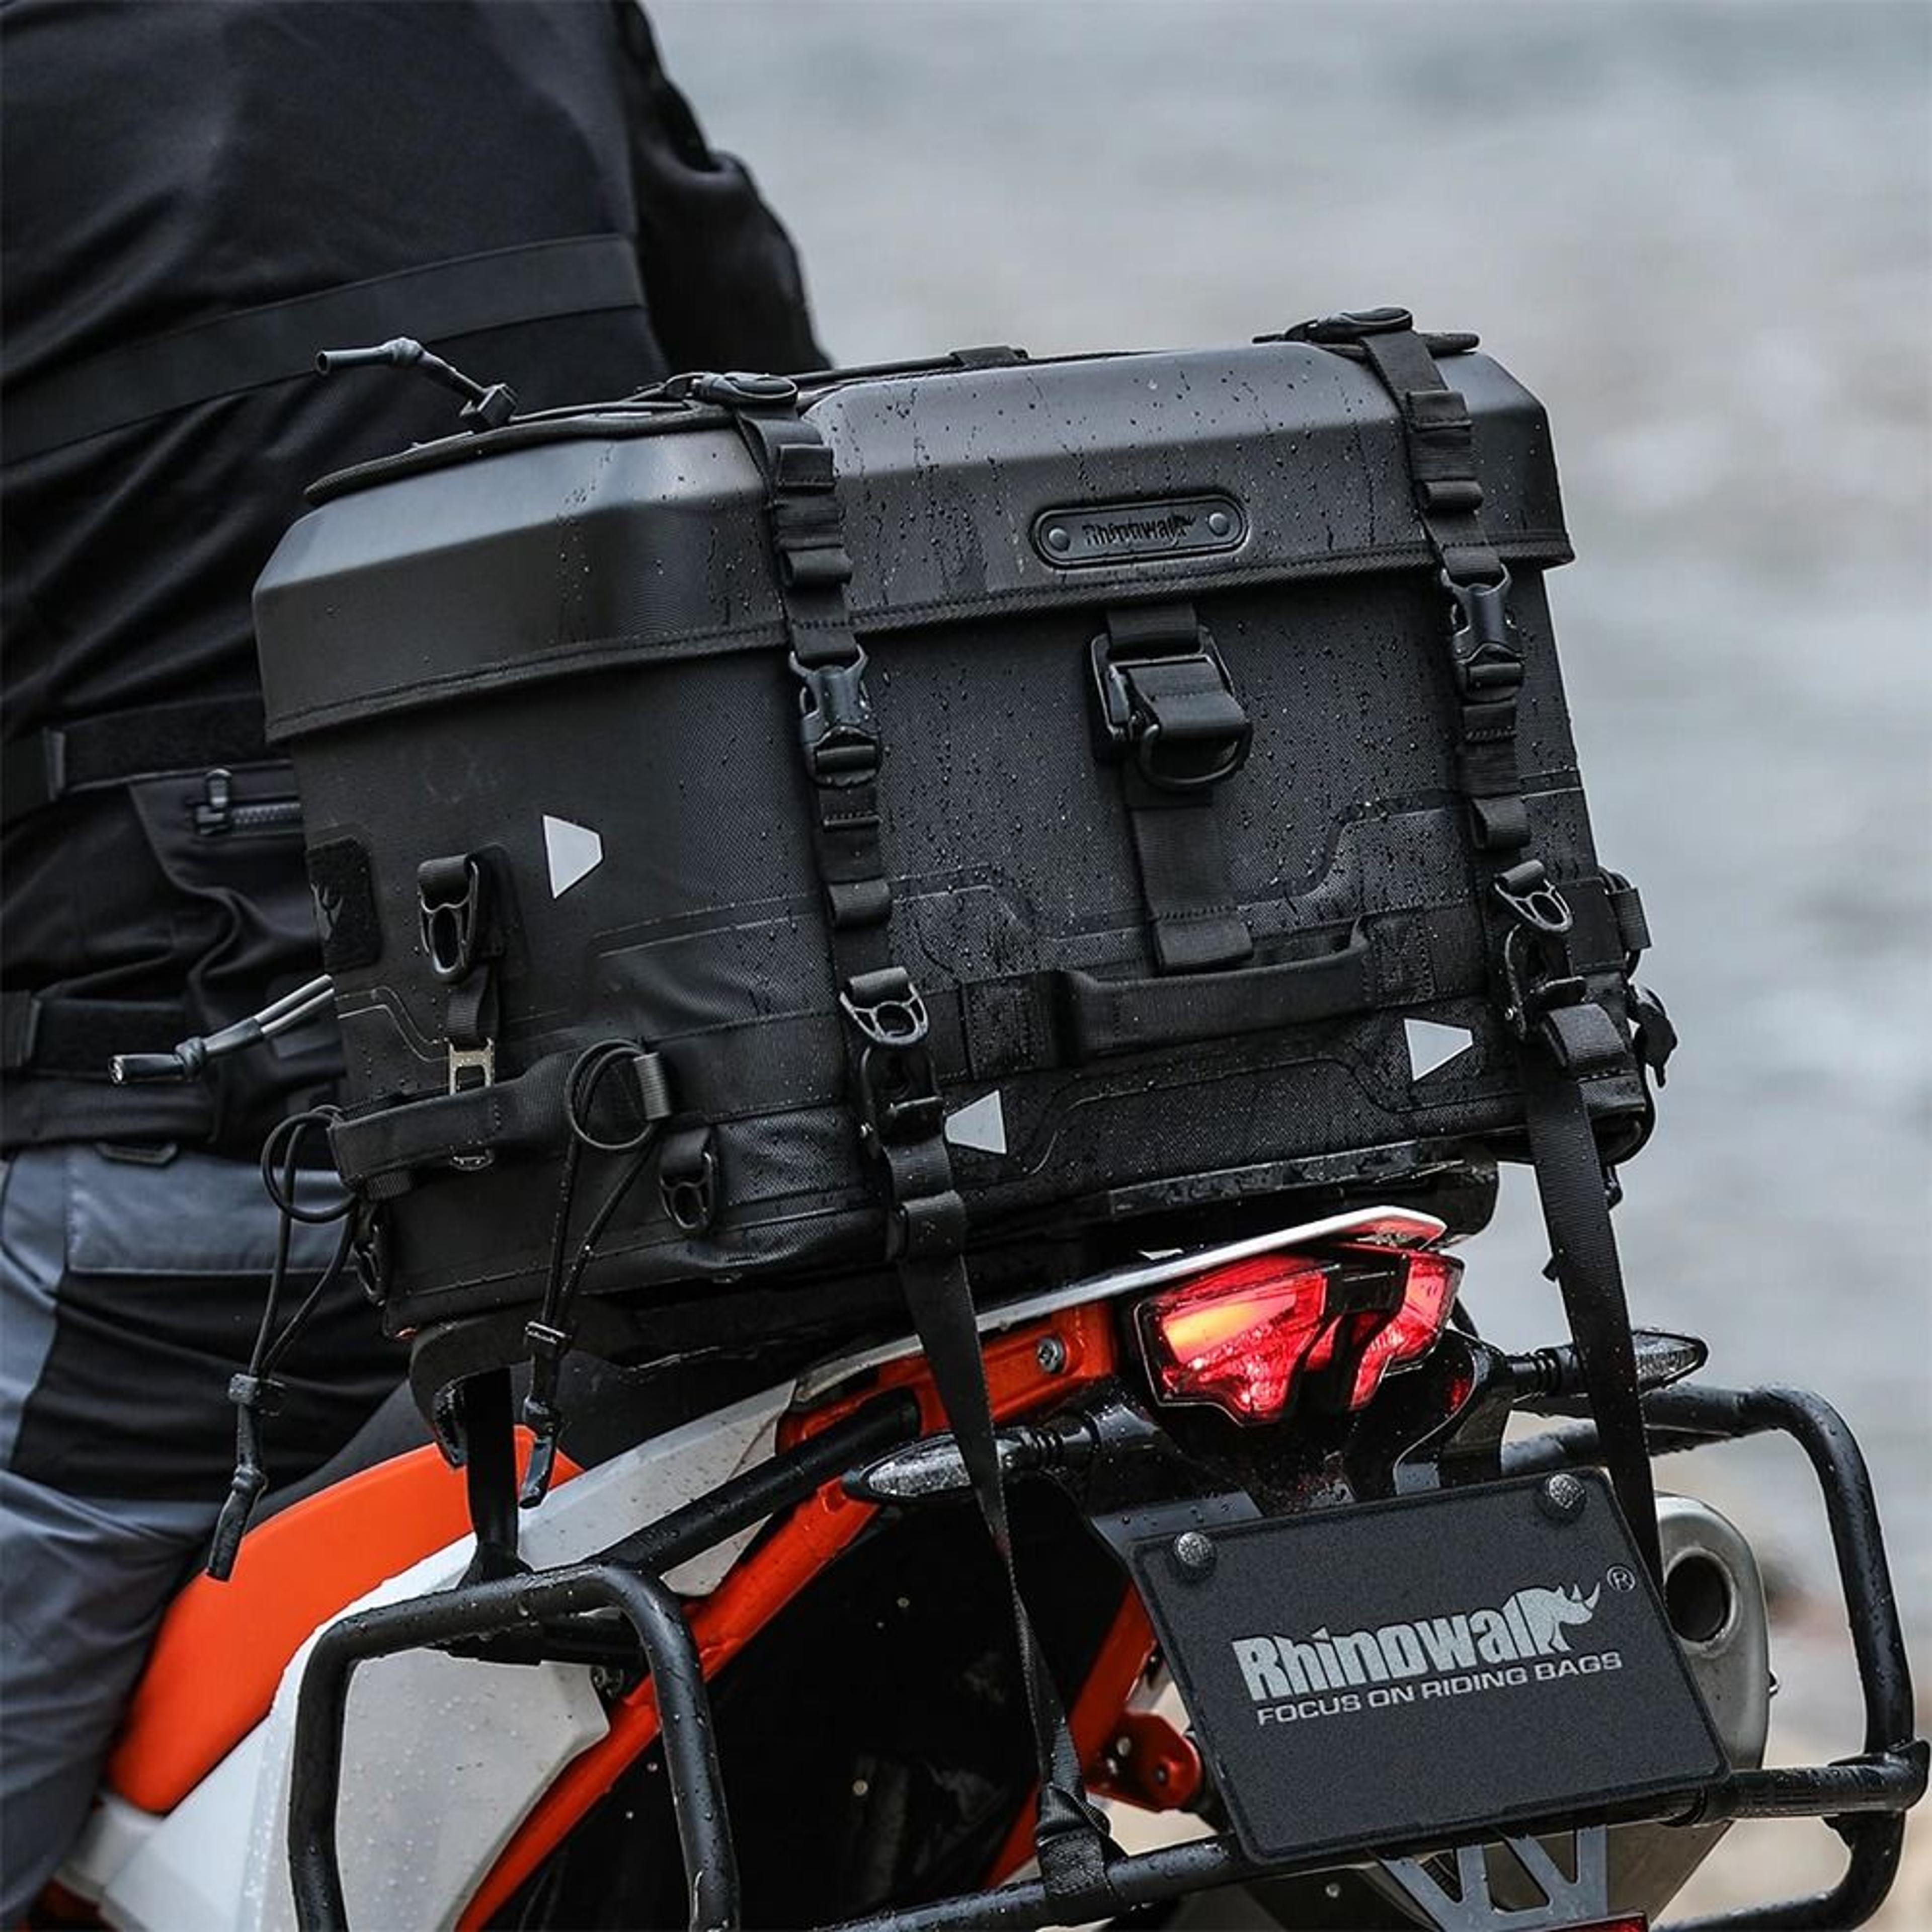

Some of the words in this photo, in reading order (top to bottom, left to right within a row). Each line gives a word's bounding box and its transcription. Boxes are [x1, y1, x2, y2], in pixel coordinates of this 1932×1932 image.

[1231, 1582, 1601, 1702] Rhinowalk
[1256, 1694, 1362, 1726] FOCUS
[1366, 1684, 1415, 1708] ON
[1420, 1666, 1529, 1700] RIDING
[1534, 1651, 1623, 1681] BAGS
